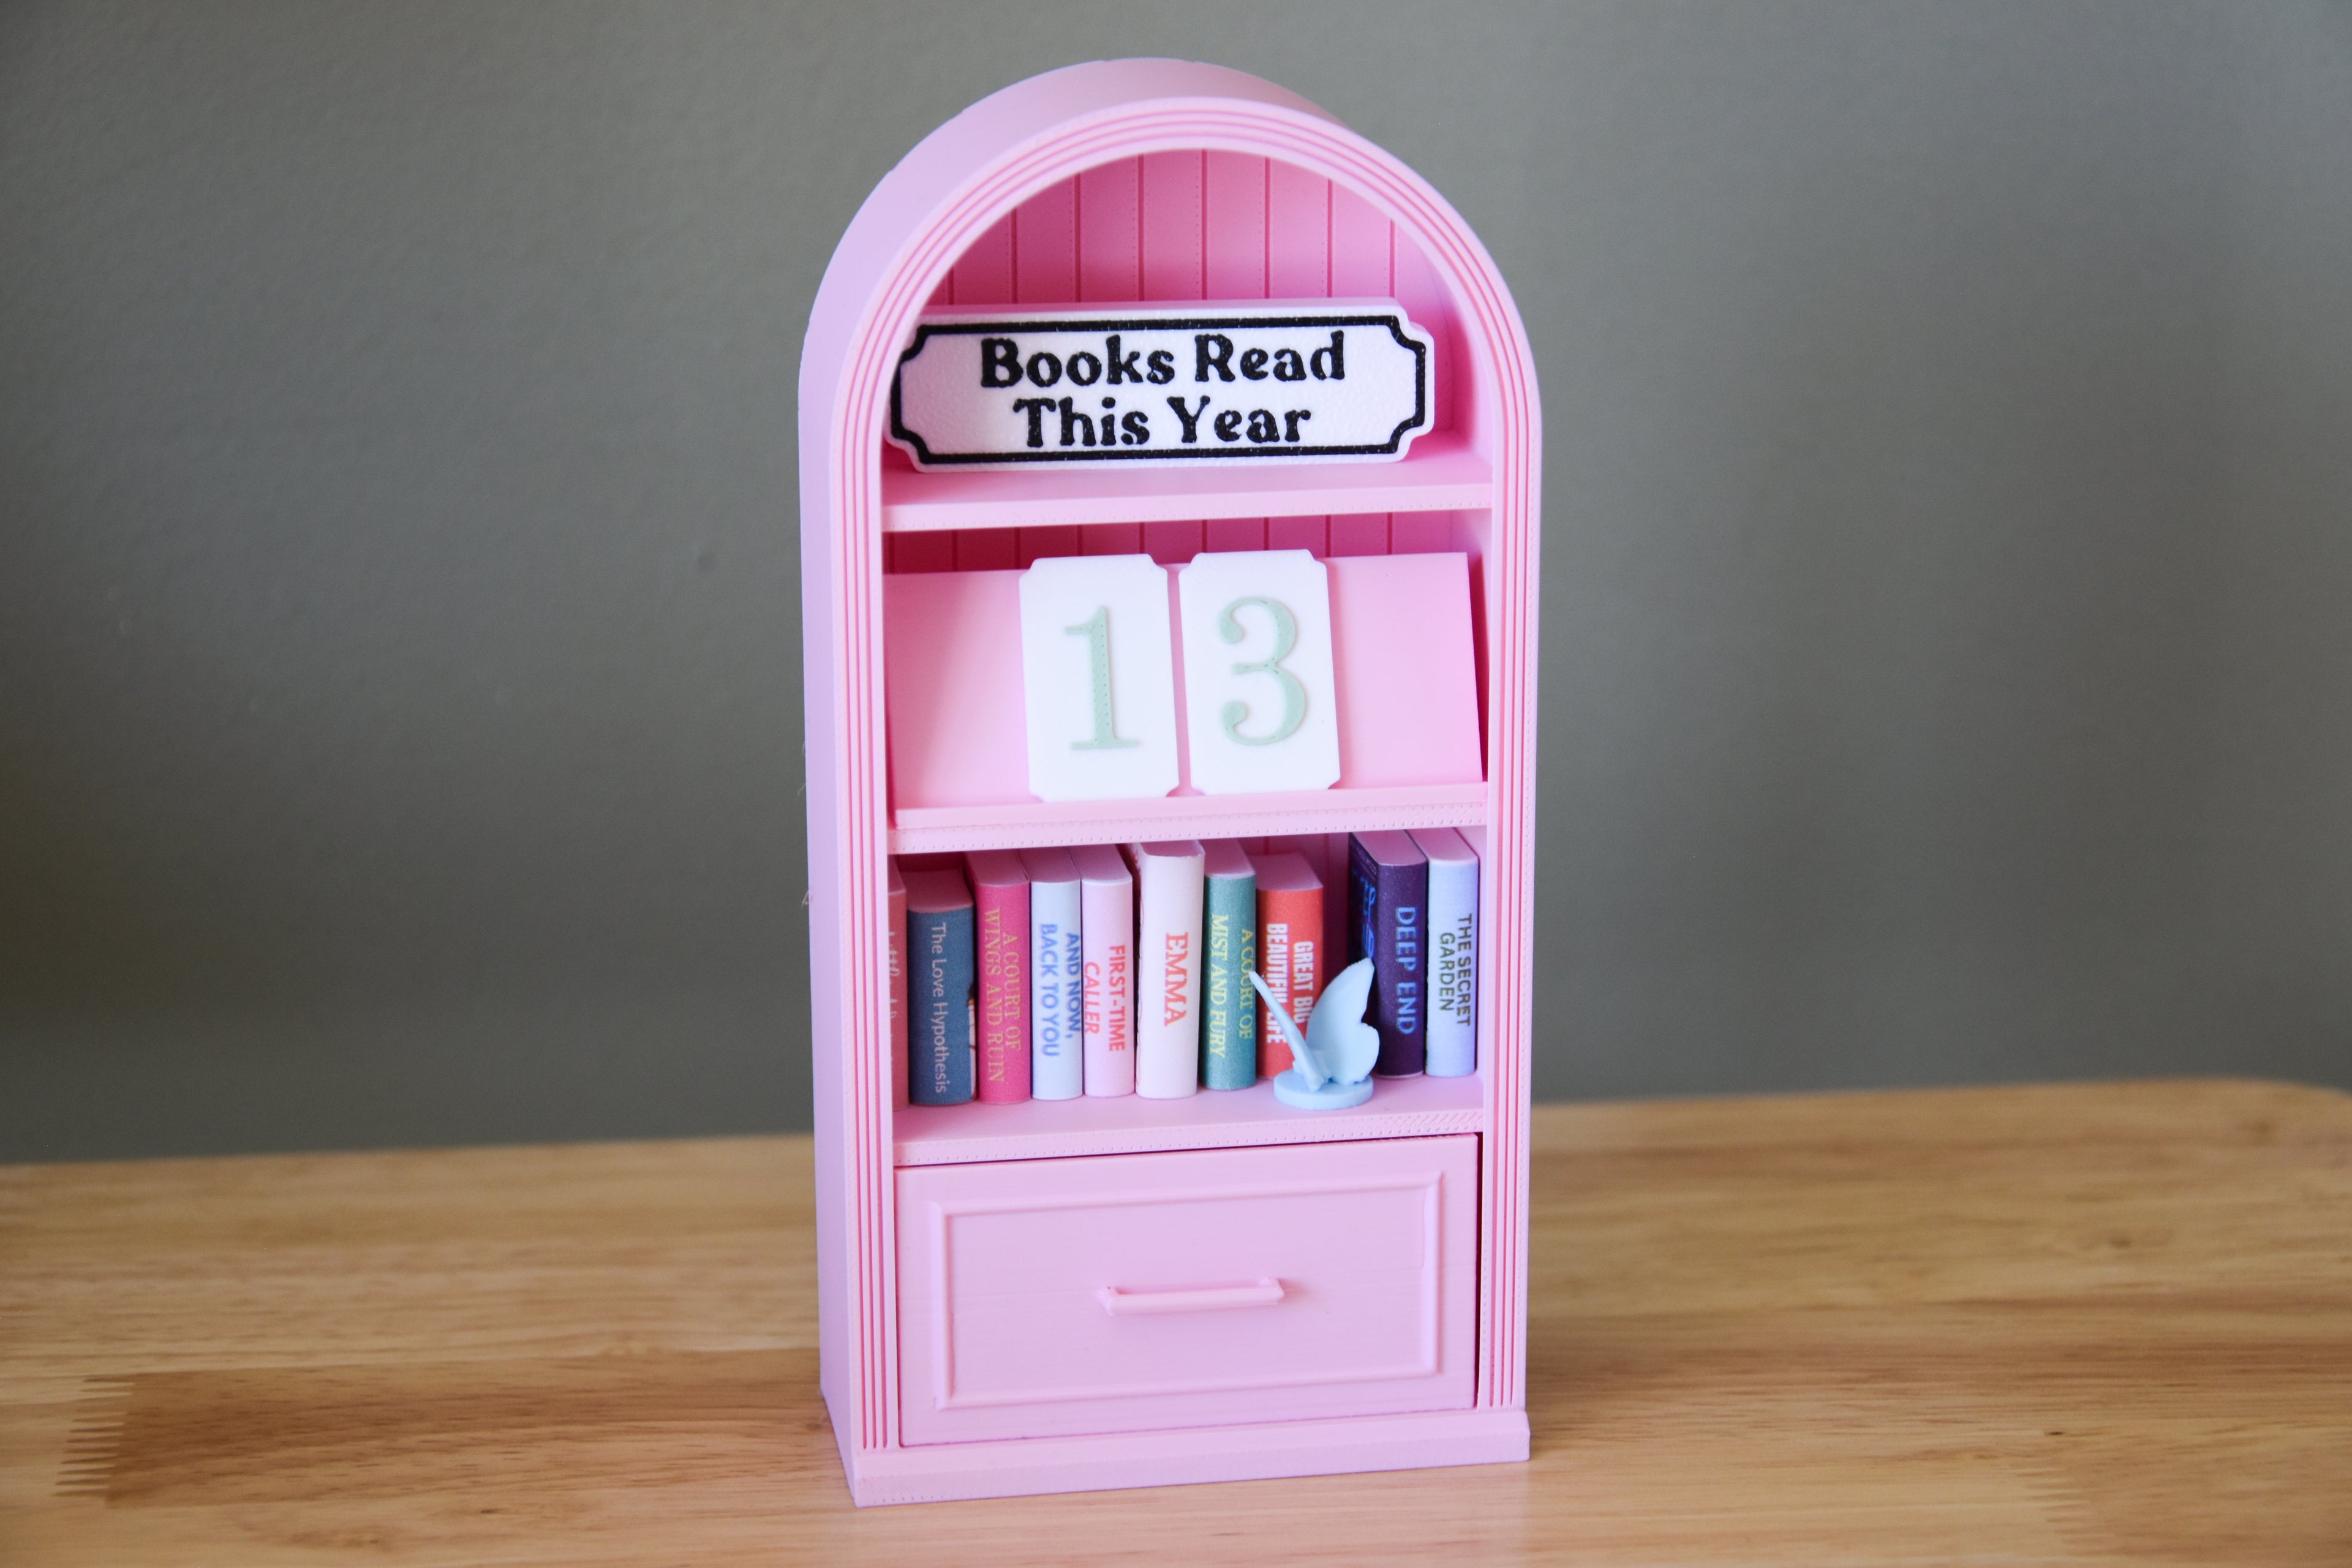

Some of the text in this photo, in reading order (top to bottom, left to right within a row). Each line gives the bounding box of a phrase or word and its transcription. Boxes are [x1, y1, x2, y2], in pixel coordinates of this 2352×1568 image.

[980, 330, 1346, 389] Books Read
[1012, 395, 1312, 448] This Year
[930, 922, 950, 1093] The Love Hypothesis
[984, 907, 1005, 1083] WINGS AND RUIN
[1003, 932, 1022, 1052] A COURT OF
[1041, 923, 1060, 1057] BACK TO YOU
[1065, 932, 1082, 1039] AND NOW,
[1084, 961, 1101, 1035] CALLER
[1109, 944, 1126, 1052] FIRST-TIME
[1164, 932, 1189, 1027] EMMA
[1209, 914, 1228, 1058] MIST AND FURY
[1238, 929, 1254, 1039] A COURT OF
[1294, 941, 1314, 1023] GREAT BIG
[1395, 907, 1418, 1035] DEEP END
[1439, 932, 1455, 1011] GARDEN
[1457, 913, 1472, 1027] THE SECRET
